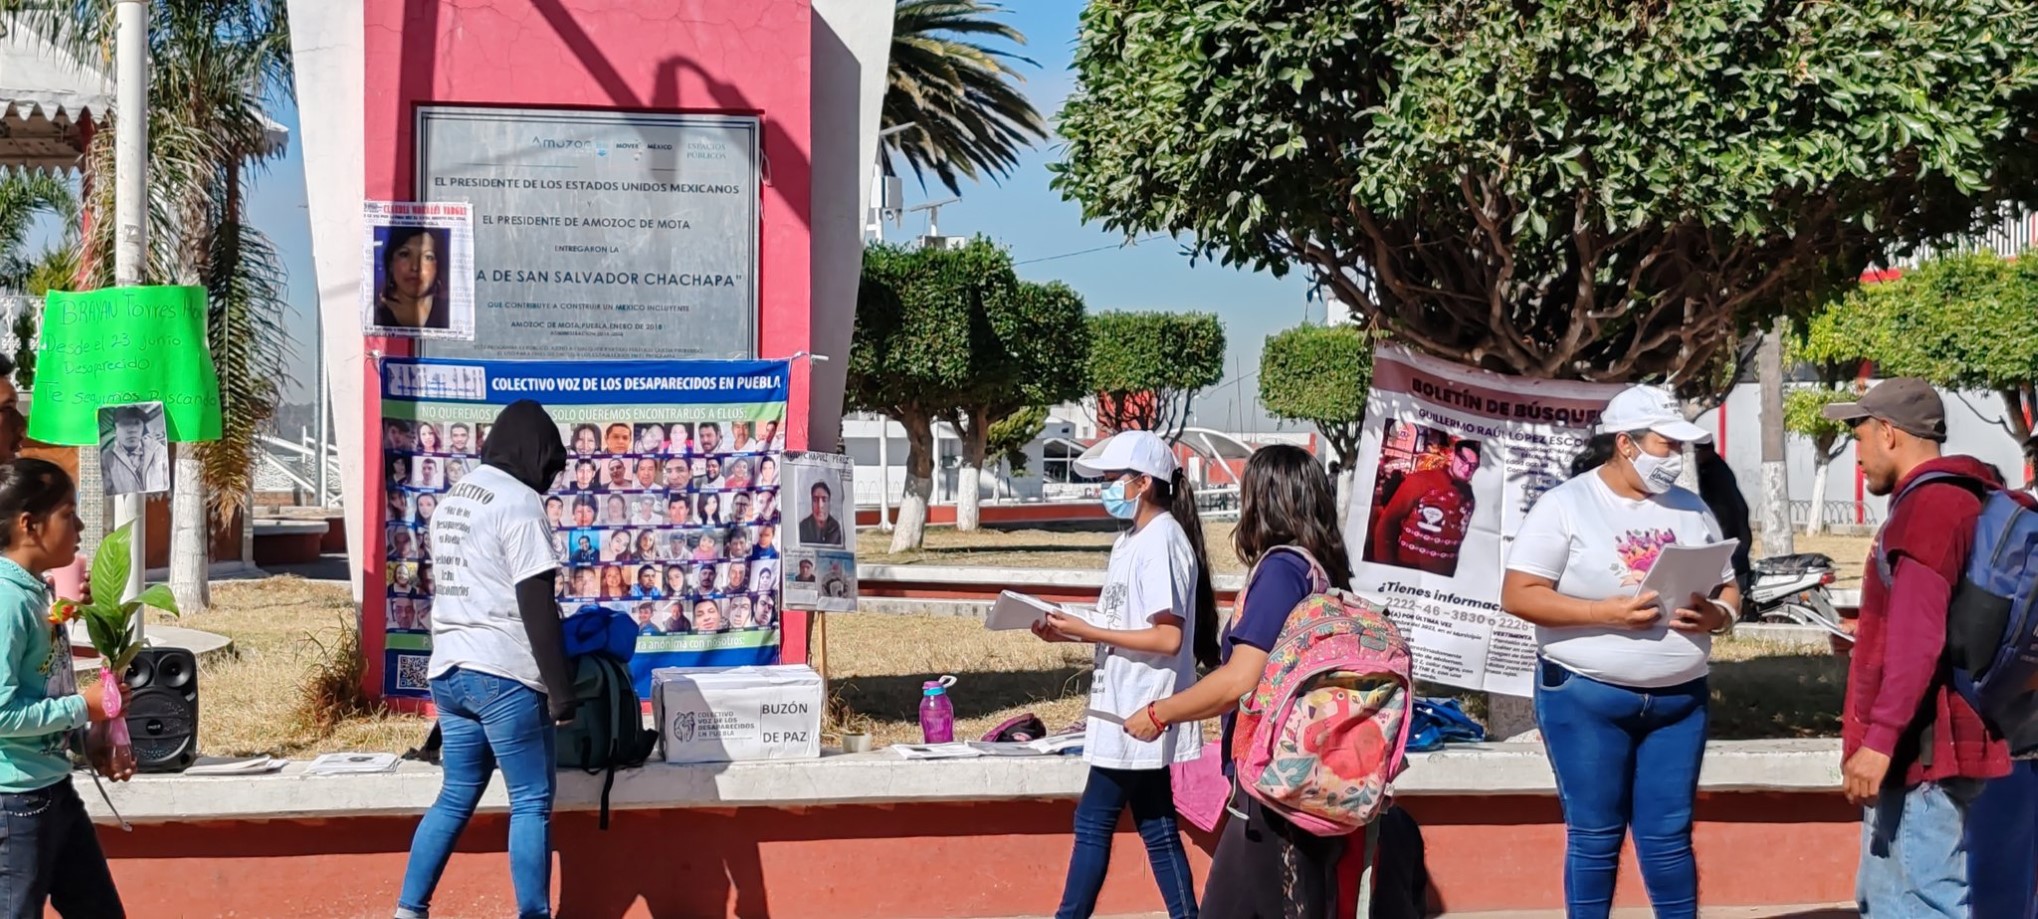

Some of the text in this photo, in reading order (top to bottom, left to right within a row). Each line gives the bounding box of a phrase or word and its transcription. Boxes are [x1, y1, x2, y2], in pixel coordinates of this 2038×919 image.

[434, 177, 740, 194] EL PRESIDENTE DE LOS ESTADOS UNIDOS MEXICANOS
[482, 215, 690, 230] EL PRESIDENTE DE AMOZOC DE MOTA
[554, 245, 619, 254] ENTREGARON LA
[492, 270, 512, 282] DE
[516, 270, 548, 283] SAN
[554, 271, 638, 285] SALVADOR
[644, 272, 742, 287] CHACHAPA"
[59, 297, 118, 325] BRAYAN
[125, 293, 177, 320] Torres
[111, 332, 132, 348] 23
[492, 377, 555, 392] COLECTIVO
[556, 378, 580, 391] VOZ
[582, 378, 598, 391] DE
[600, 378, 622, 390] LOS
[624, 376, 716, 390] DESAPARECIDOS
[719, 376, 734, 390] EN
[737, 375, 781, 390] PUEBLA
[1412, 377, 1482, 411] BOLETÍN
[1486, 399, 1510, 416] DE
[422, 406, 436, 418] NO
[438, 407, 491, 421] QUEREMOS
[552, 410, 576, 420] SOLO
[578, 408, 631, 421] QUEREMOS
[634, 408, 706, 421] ENCONTRARLOS
[708, 408, 716, 420] A
[1418, 408, 1475, 433] GUILLERMO
[1477, 424, 1506, 439] RAÚL
[1378, 582, 1432, 598] ¿Tienes
[1440, 620, 1452, 628] VEZ
[1488, 618, 1496, 626] o
[648, 638, 687, 650] anónima
[689, 640, 704, 649] con
[762, 700, 808, 715] BUZÓN
[698, 722, 755, 730] DESAPARECIDOS
[698, 730, 708, 738] EN
[763, 732, 807, 744] DE PAZ
